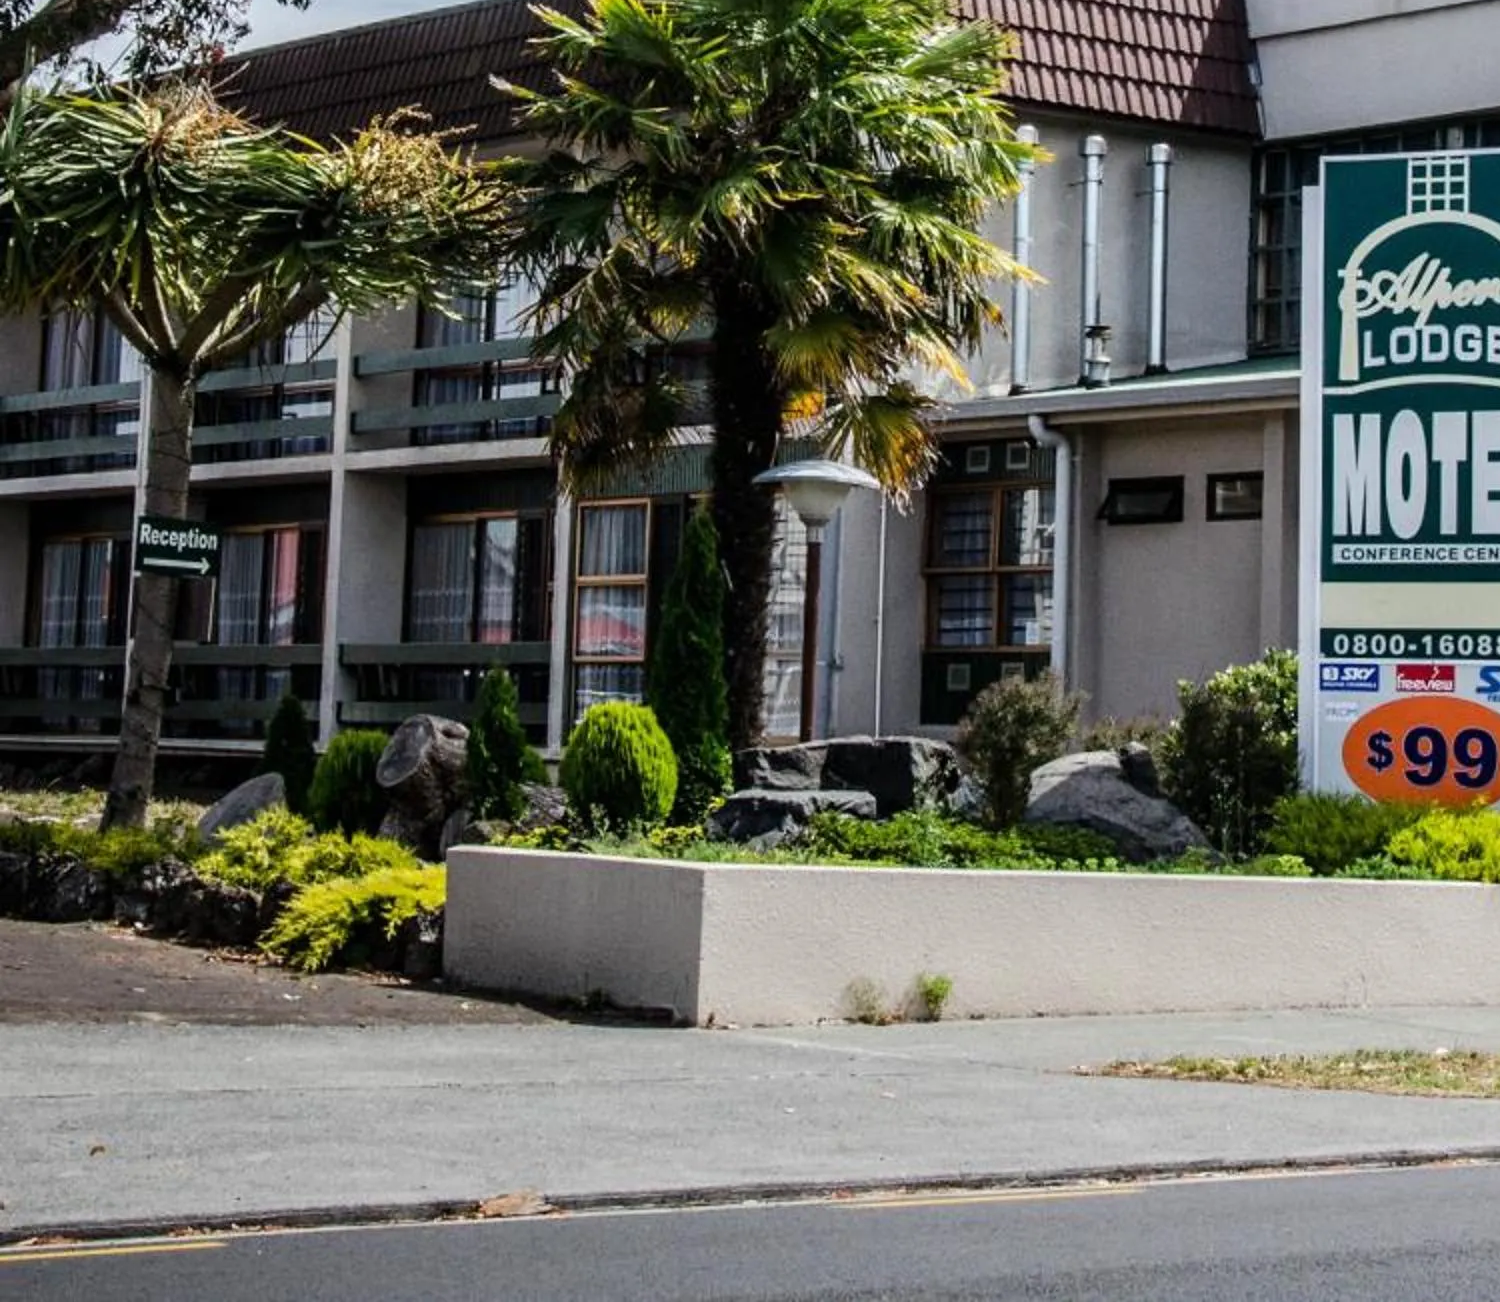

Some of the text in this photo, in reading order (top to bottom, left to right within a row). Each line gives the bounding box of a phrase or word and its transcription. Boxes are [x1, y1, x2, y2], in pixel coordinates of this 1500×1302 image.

[140, 523, 218, 553] Reception
[1341, 547, 1459, 560] CONFERENCE
[1366, 726, 1498, 789] $99
